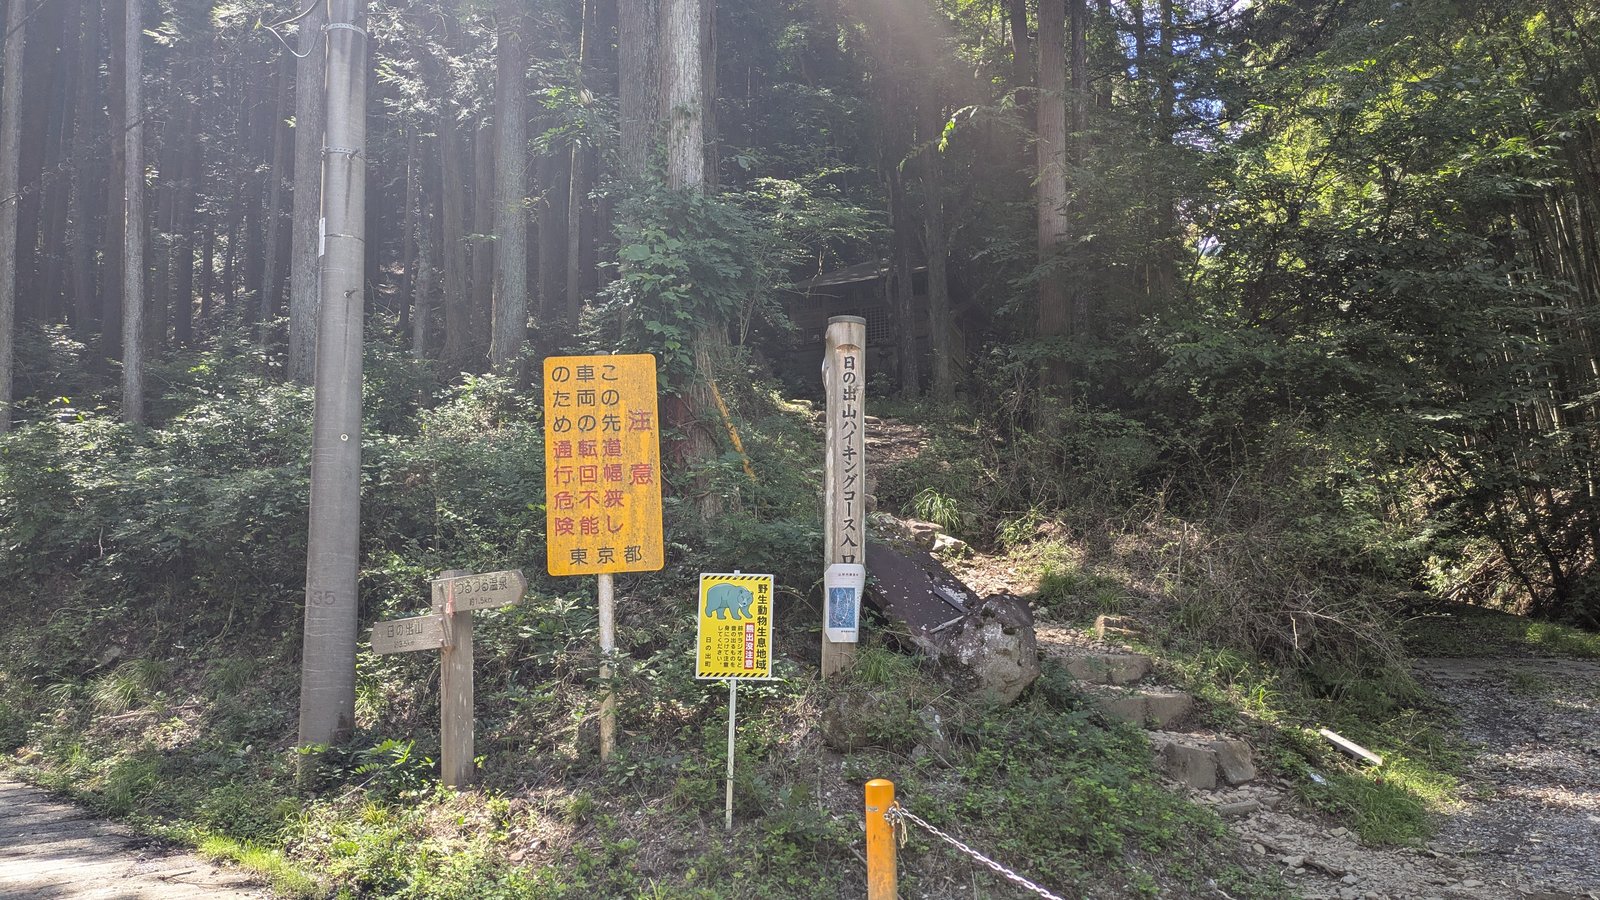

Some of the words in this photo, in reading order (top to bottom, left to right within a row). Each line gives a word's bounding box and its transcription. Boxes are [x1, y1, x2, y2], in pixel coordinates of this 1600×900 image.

[552, 366, 574, 536] のため通行危険
[576, 365, 599, 536] 車両の転回不能
[601, 364, 624, 534] この先道幅狭し
[628, 409, 653, 485] 注意
[841, 355, 858, 564] 日の出山ハイキングコース入口
[455, 576, 508, 594] つるつる温泉
[569, 545, 642, 566] 東京都
[387, 621, 423, 638] 日の出山
[756, 583, 768, 671] 野生動物生息地域
